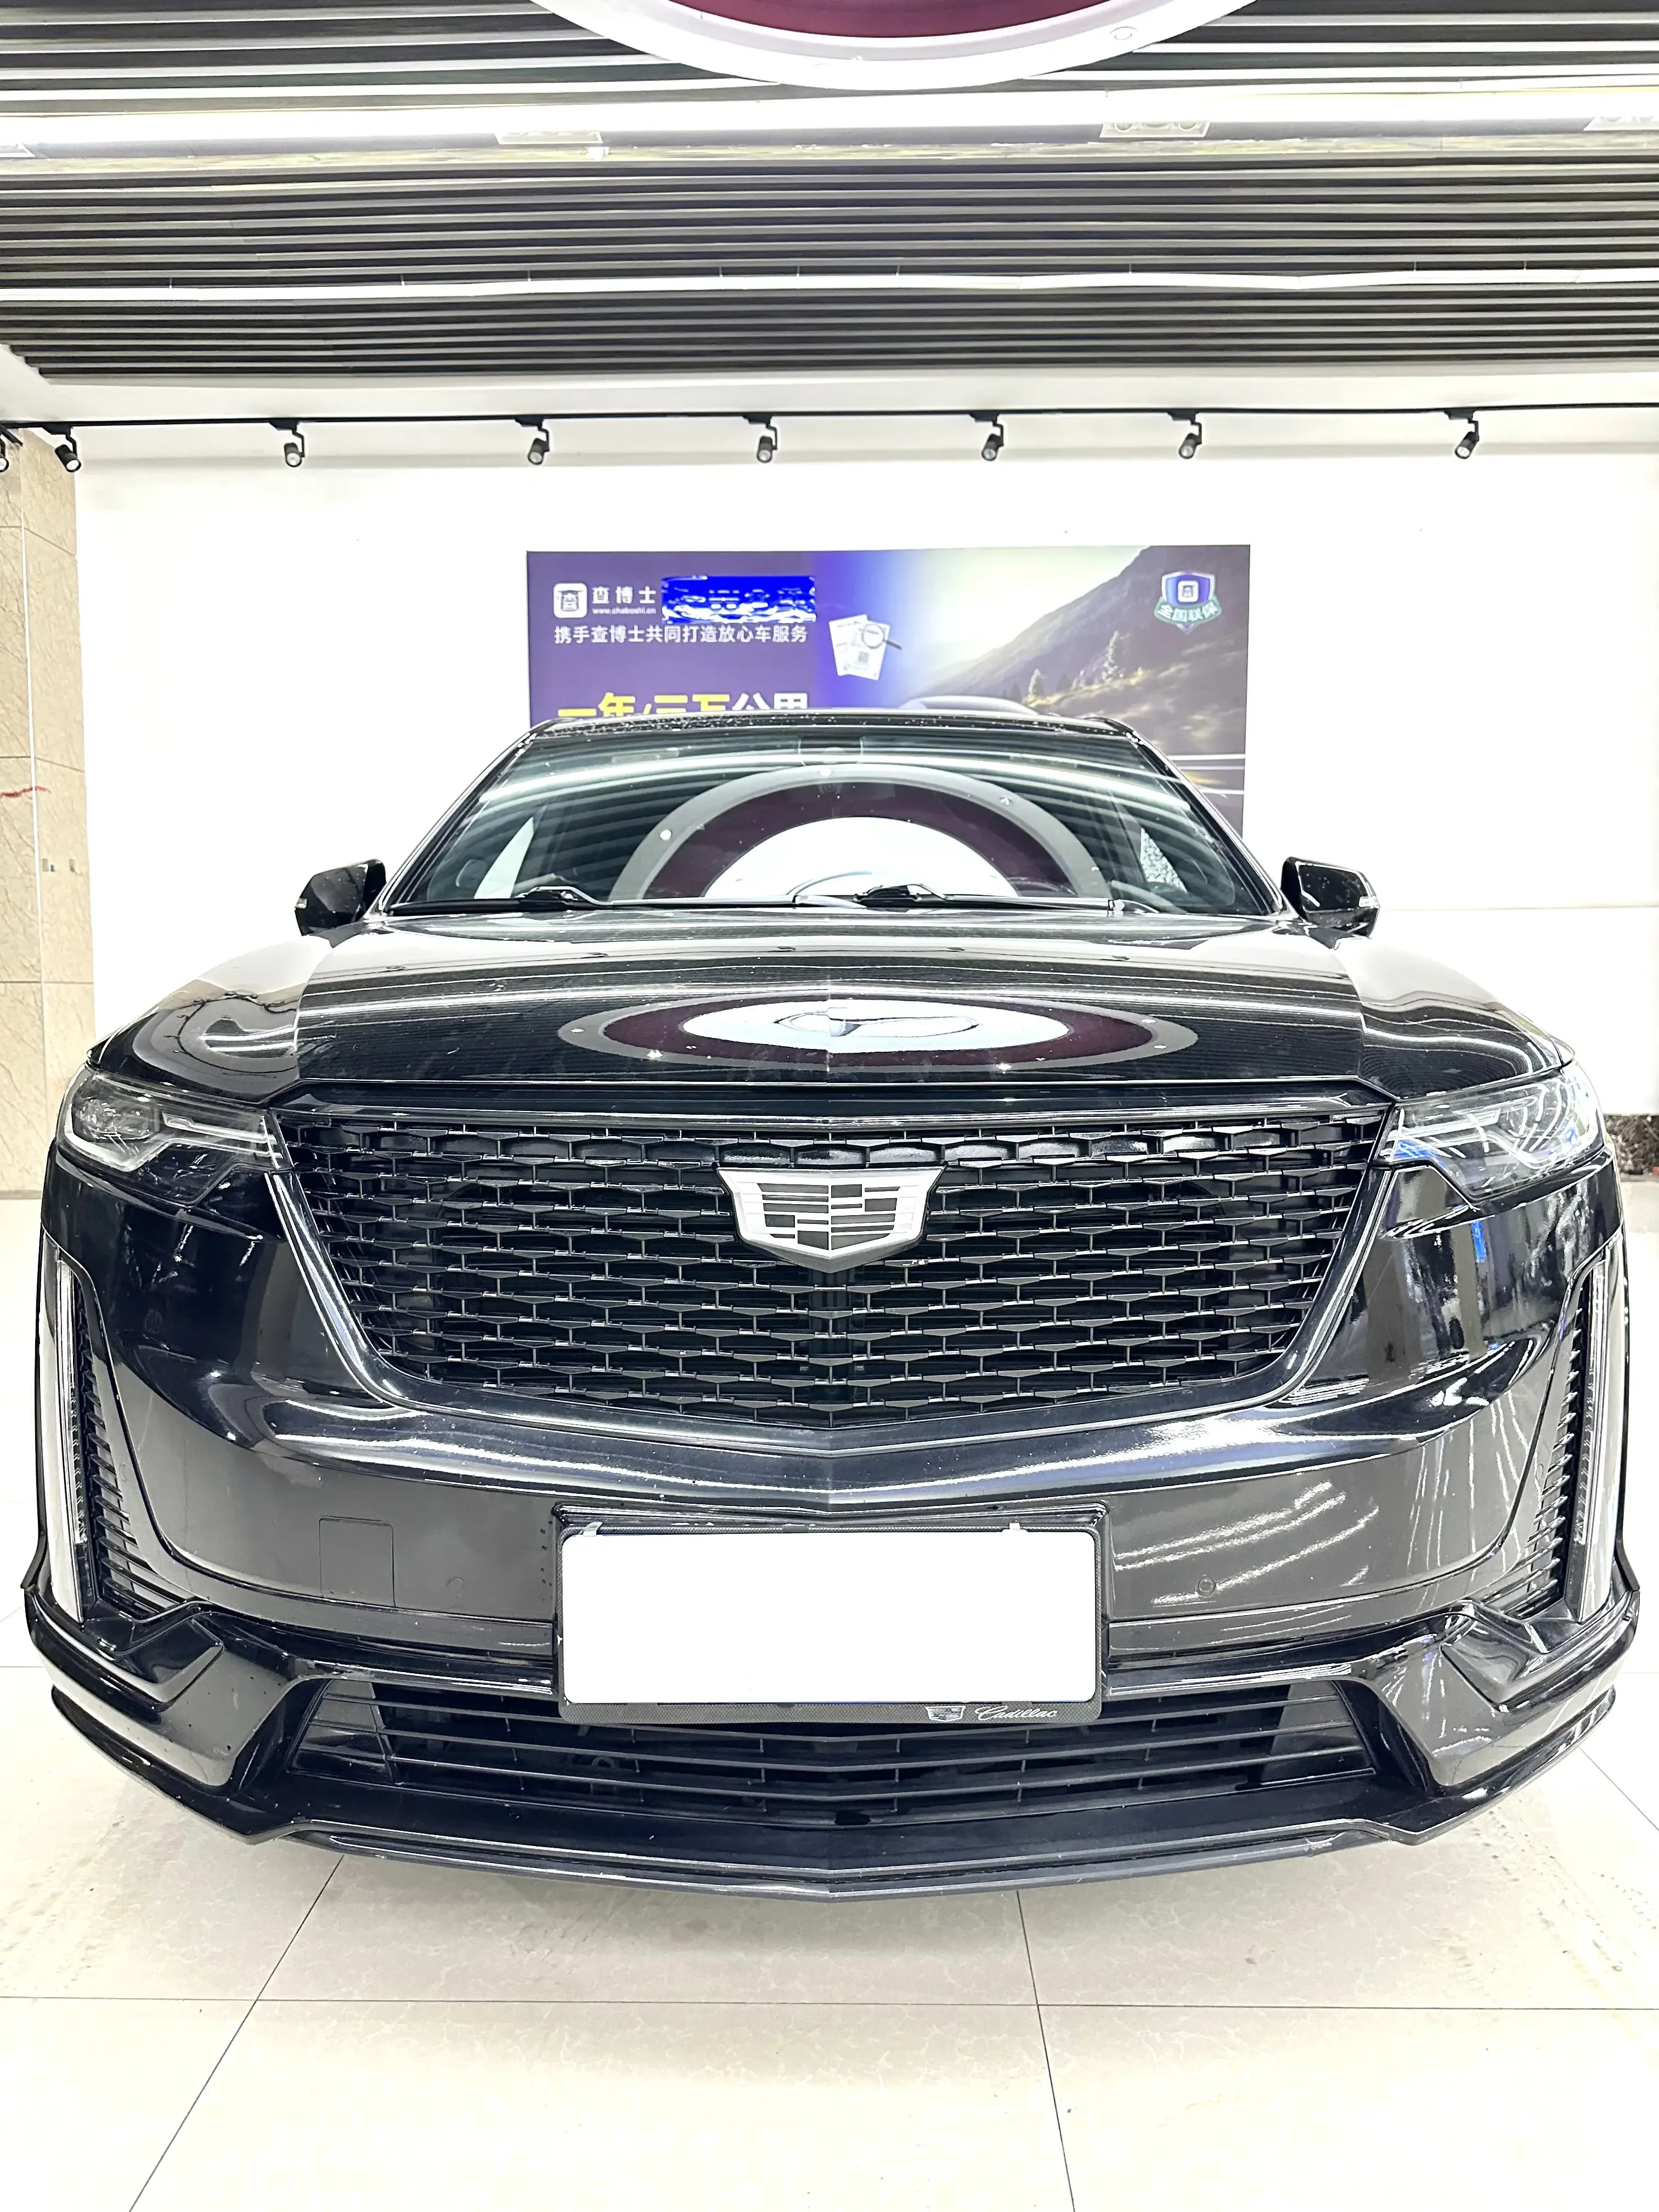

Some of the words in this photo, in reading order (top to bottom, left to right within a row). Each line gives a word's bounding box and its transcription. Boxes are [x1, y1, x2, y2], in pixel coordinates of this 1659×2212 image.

[592, 585, 657, 603] 查博士
[554, 624, 808, 644] 携手查博士共同打造放心车服务
[975, 1705, 1058, 1720] Cadillac
